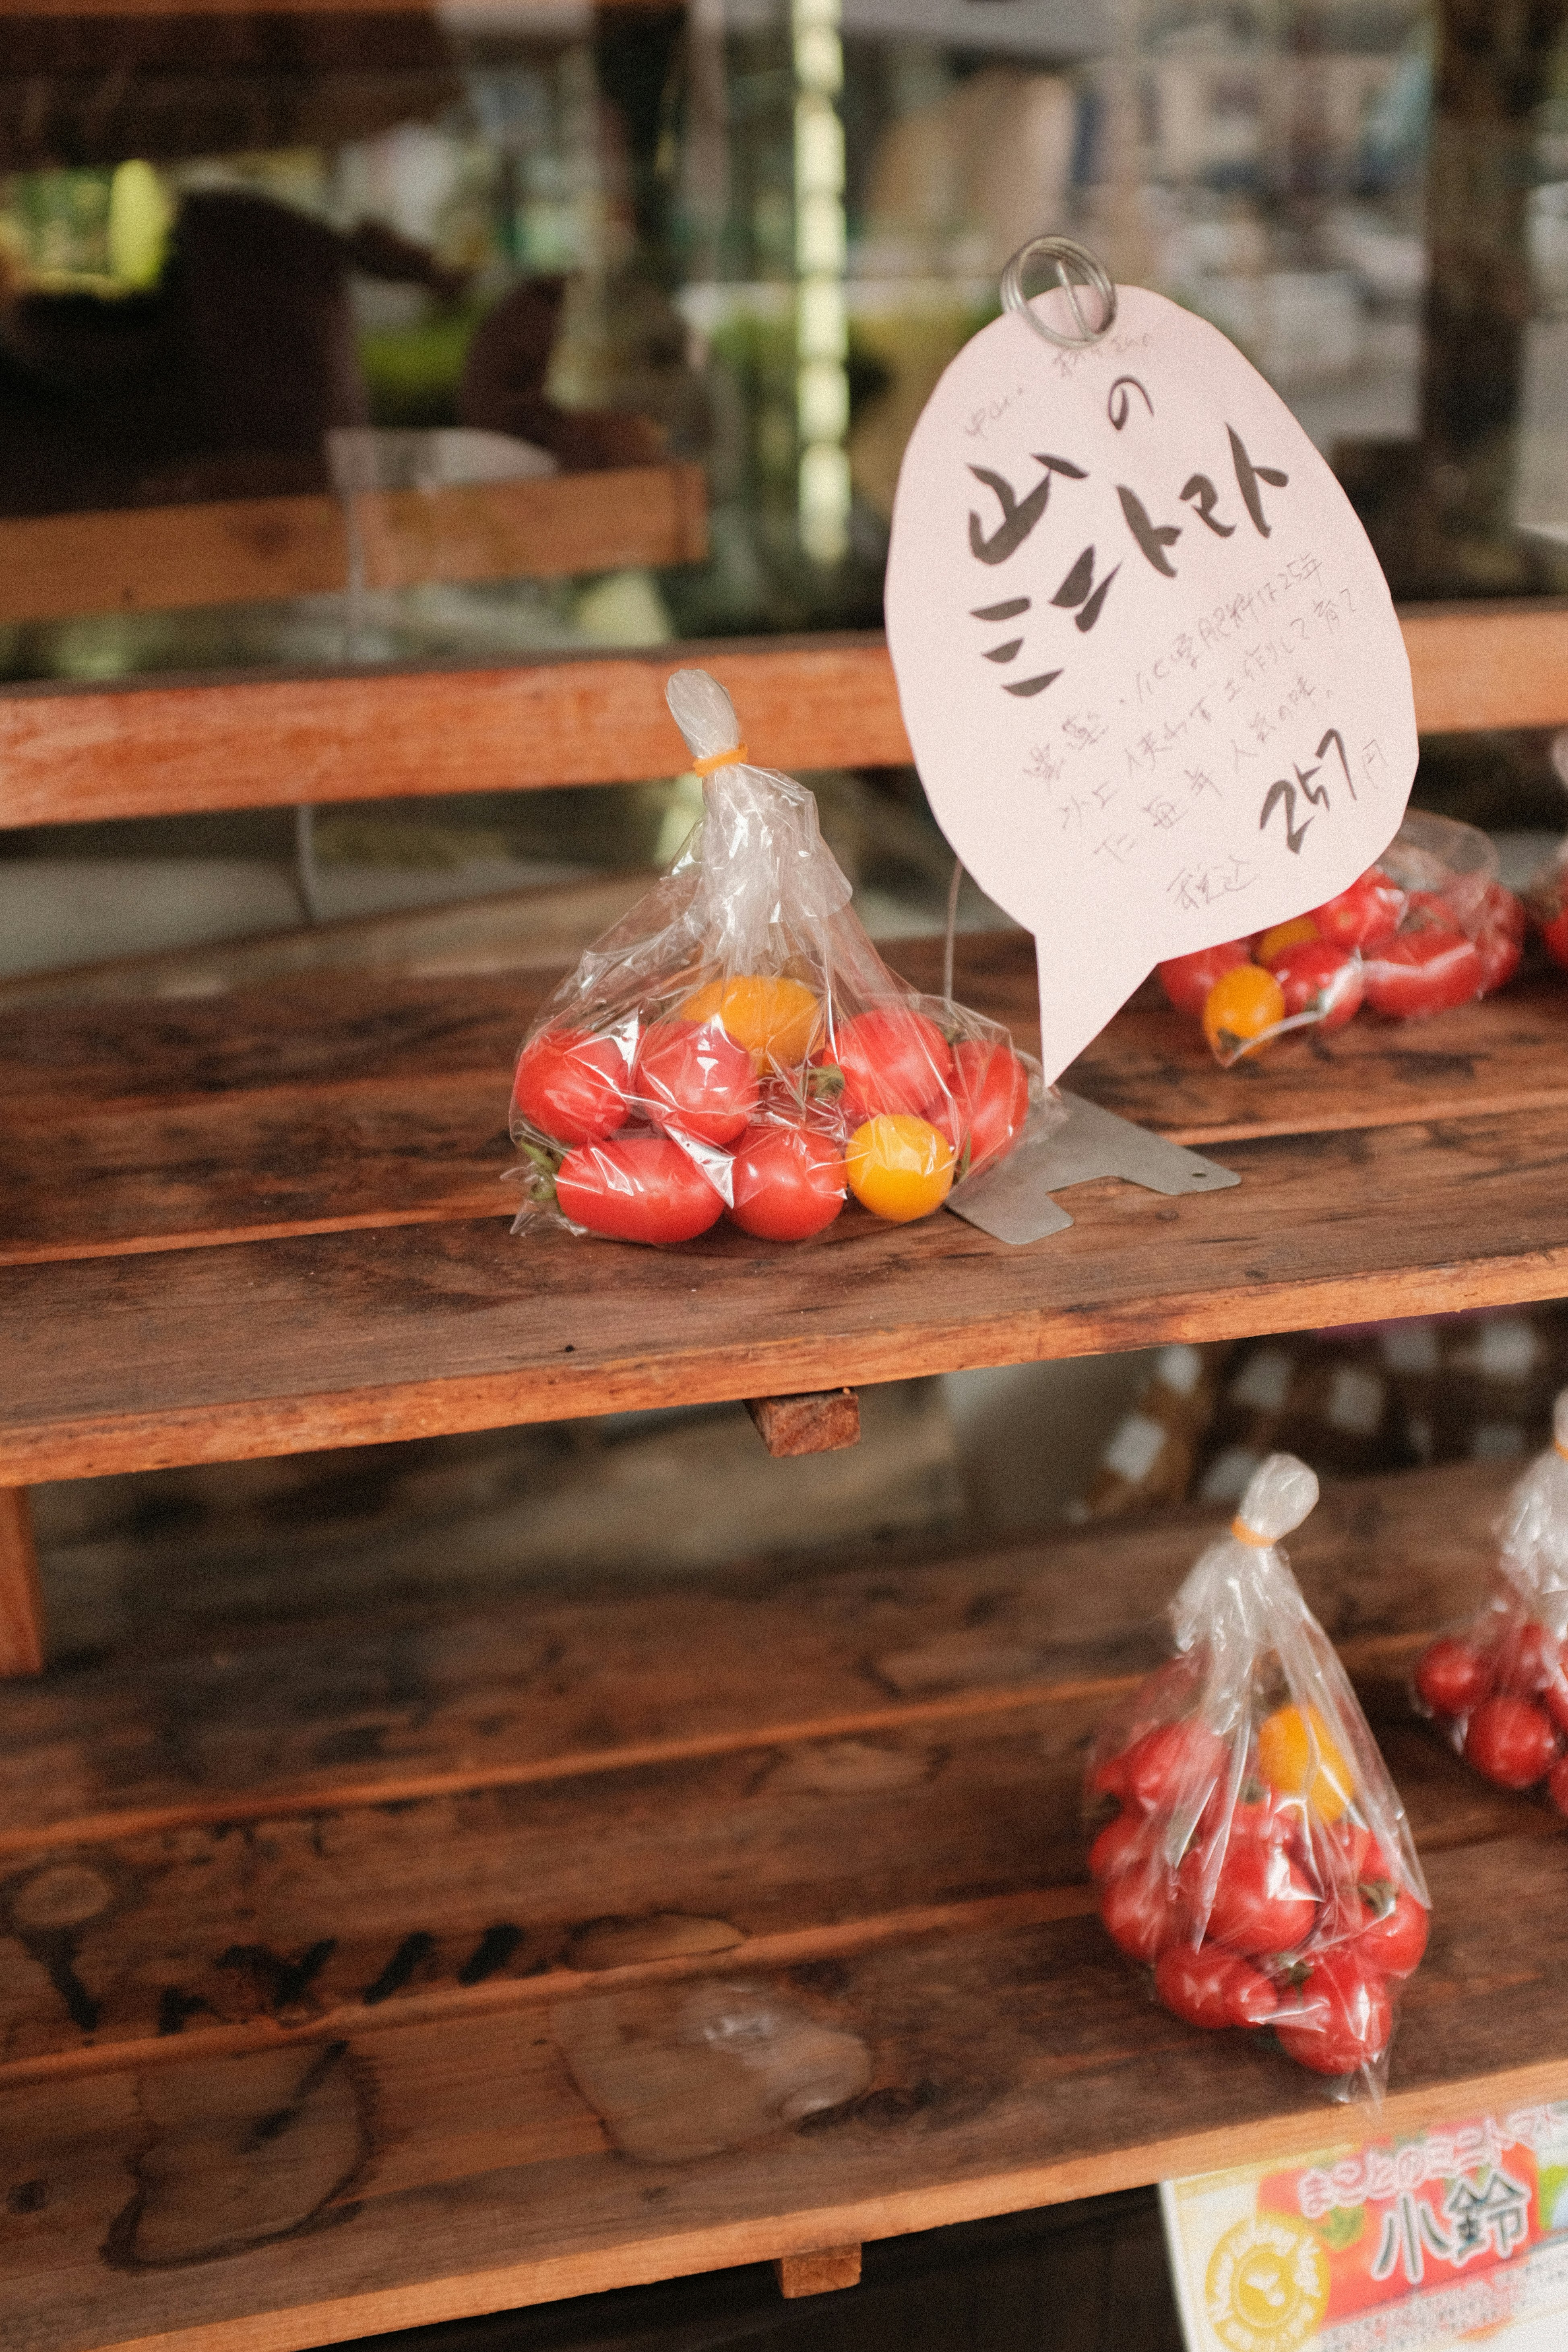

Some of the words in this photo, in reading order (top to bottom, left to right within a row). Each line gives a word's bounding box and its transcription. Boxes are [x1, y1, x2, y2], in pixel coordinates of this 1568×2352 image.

[968, 421, 1289, 697] ミニトマト
[1371, 2166, 1531, 2284] 小鈴
